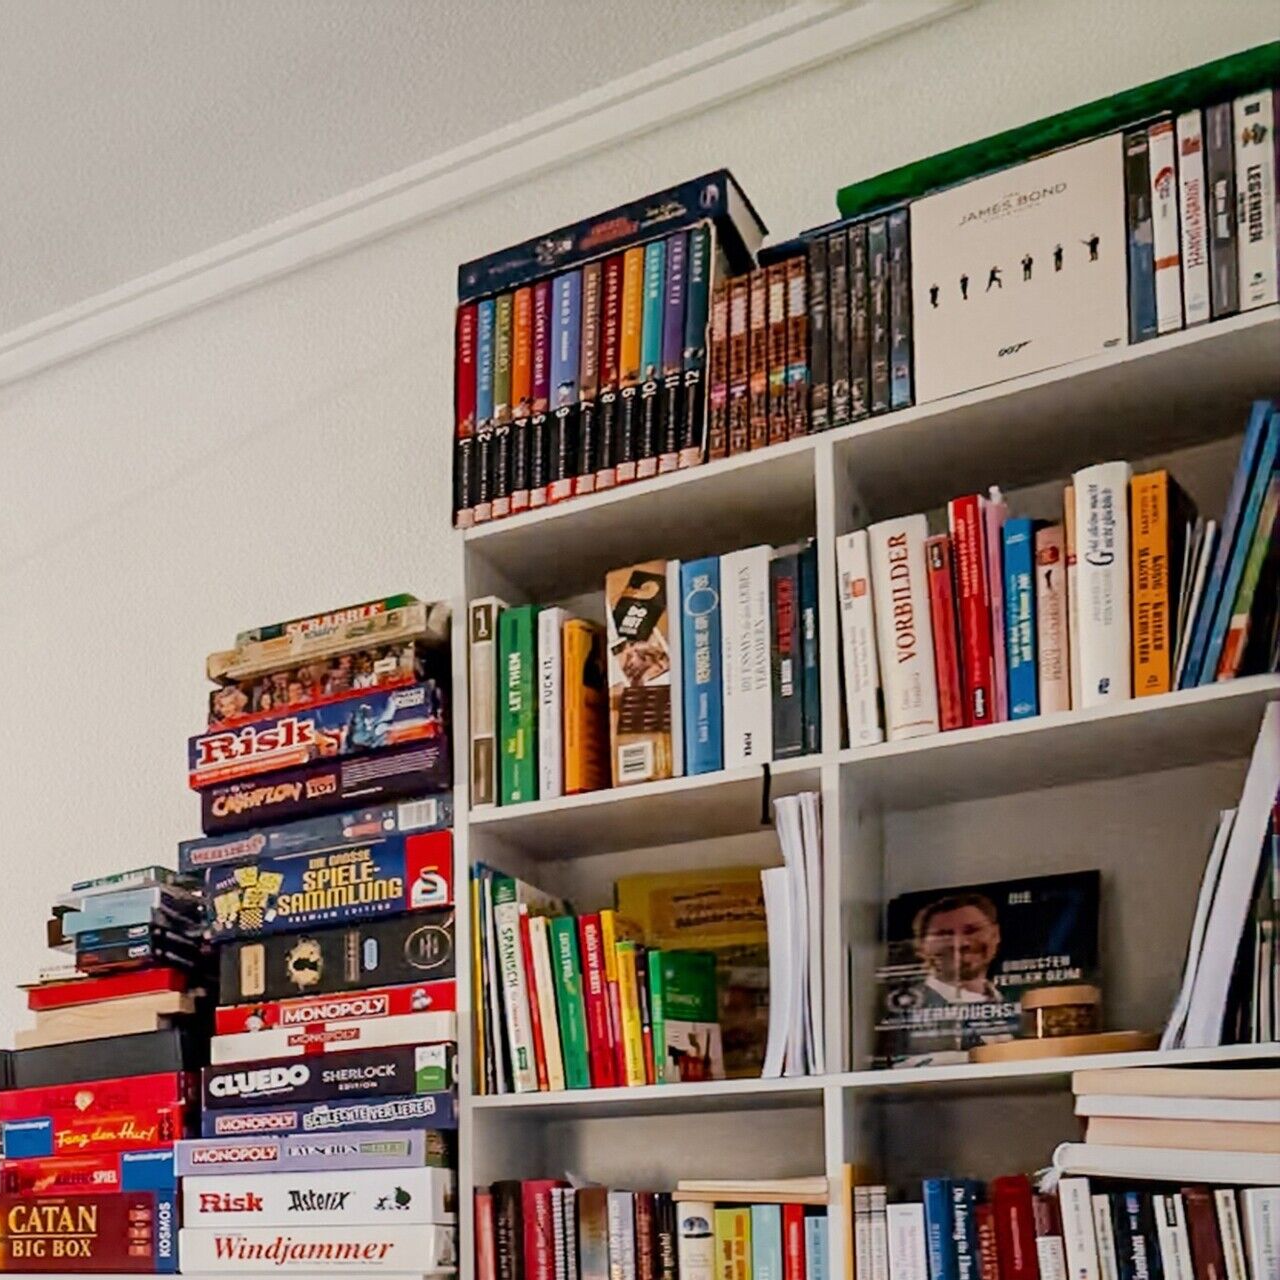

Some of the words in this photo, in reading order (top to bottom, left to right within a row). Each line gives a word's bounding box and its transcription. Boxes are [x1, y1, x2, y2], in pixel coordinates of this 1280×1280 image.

[959, 199, 1013, 226] JAMES
[1016, 182, 1068, 205] BOND
[887, 532, 917, 664] VORBILDER
[286, 602, 385, 637] SCRABBLE
[508, 652, 522, 687] THEM
[509, 690, 522, 712] LET
[199, 718, 316, 766] Risk
[309, 779, 335, 795] 101
[309, 857, 327, 870] DIE
[329, 848, 371, 867] GROSSE
[303, 861, 381, 893] SPIELE-
[277, 877, 403, 917] SAMMLUNG
[501, 927, 518, 989] SPANISCH
[283, 998, 386, 1025] MONOPOLY
[289, 1029, 359, 1045] MONOPOLY
[209, 1064, 310, 1097] CLUEDO
[322, 1063, 396, 1083] SHERLOCK
[217, 1113, 296, 1132] MONOPOLY
[367, 1096, 436, 1123] VERLIERER
[55, 1131, 90, 1149] Fang
[91, 1126, 116, 1142] den
[117, 1122, 158, 1142] Hut!
[193, 1145, 278, 1163] MONOPOLY
[92, 1169, 118, 1185] SPIEL
[199, 1193, 263, 1213] Risk
[288, 1190, 354, 1212] Asterix
[8, 1204, 98, 1234] CATAN
[158, 1201, 171, 1258] KOSMOS
[12, 1240, 45, 1258] BIG
[53, 1239, 92, 1257] BOX
[214, 1236, 395, 1266] Windjammer
